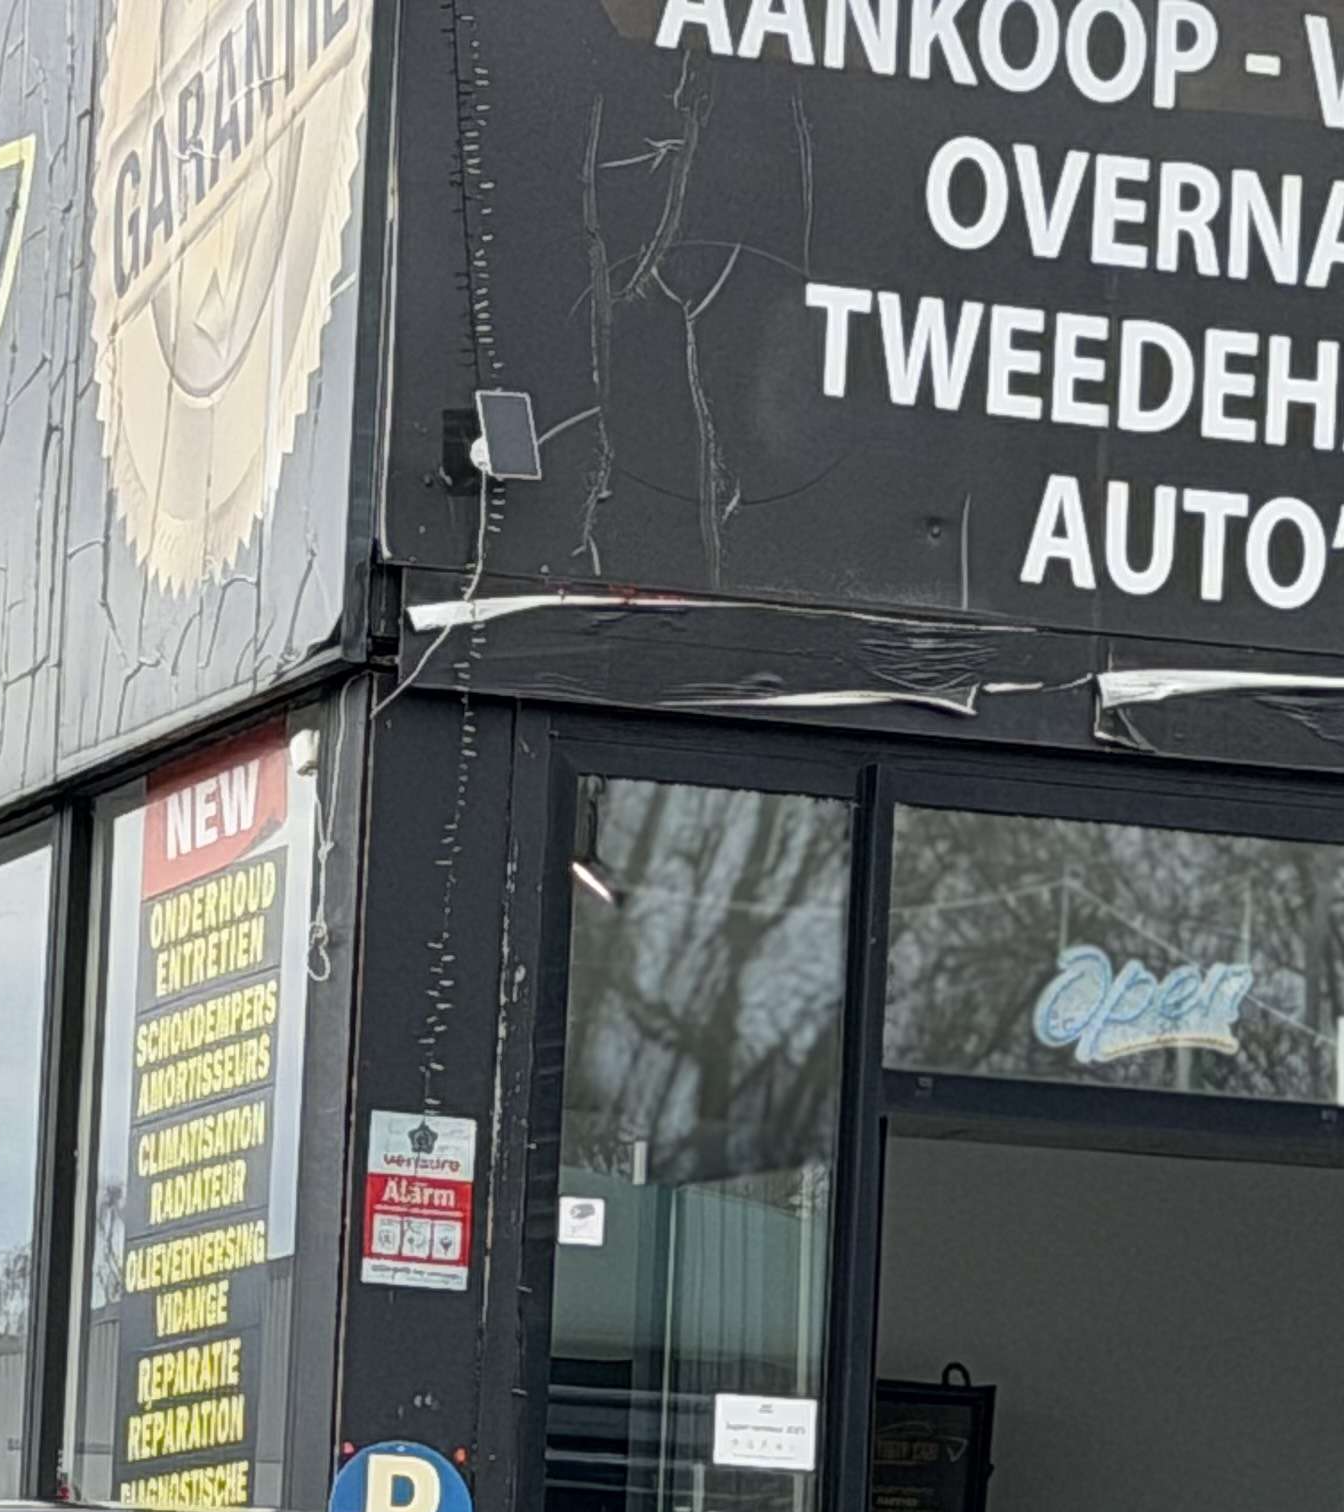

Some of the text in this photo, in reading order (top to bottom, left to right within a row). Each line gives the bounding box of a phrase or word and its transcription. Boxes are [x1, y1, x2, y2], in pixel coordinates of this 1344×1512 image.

[113, 0, 349, 299] GARANT
[166, 758, 260, 862] NEW
[149, 861, 276, 949] ONDERHOUD
[156, 915, 265, 998] ENTRETIEN
[136, 979, 277, 1068] SCHOKDEMPERS
[1034, 945, 1254, 1062] Open
[137, 1033, 270, 1118] AMORTISSEURS
[138, 1102, 265, 1177] CLIMATISATION
[150, 1159, 247, 1225] RADIATEUR
[382, 1176, 456, 1207] Alarm
[125, 1220, 265, 1293] OLIEVERVERSING
[156, 1279, 230, 1337] VIDANGE
[137, 1336, 242, 1404] REPARATIE
